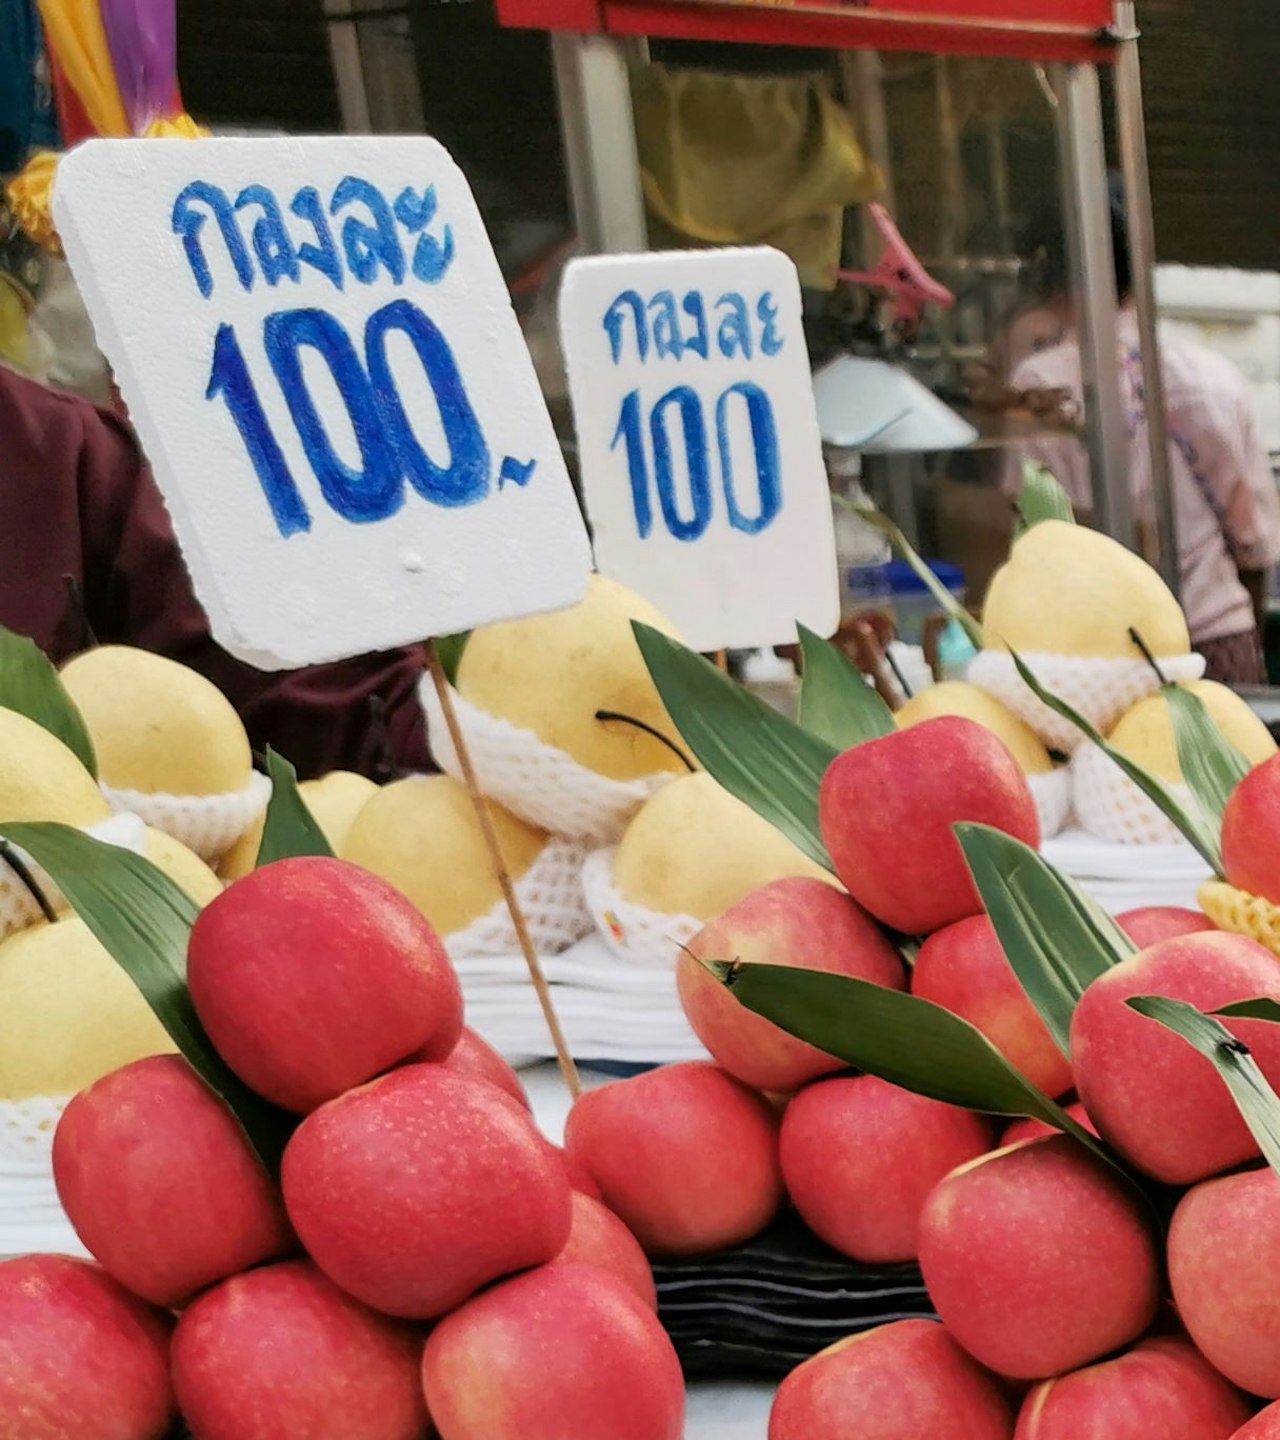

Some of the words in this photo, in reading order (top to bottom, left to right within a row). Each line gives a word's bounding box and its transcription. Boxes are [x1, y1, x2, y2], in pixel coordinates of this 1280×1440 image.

[172, 177, 455, 300] กองละ
[603, 290, 784, 365] กองละ
[611, 382, 783, 542] 100
